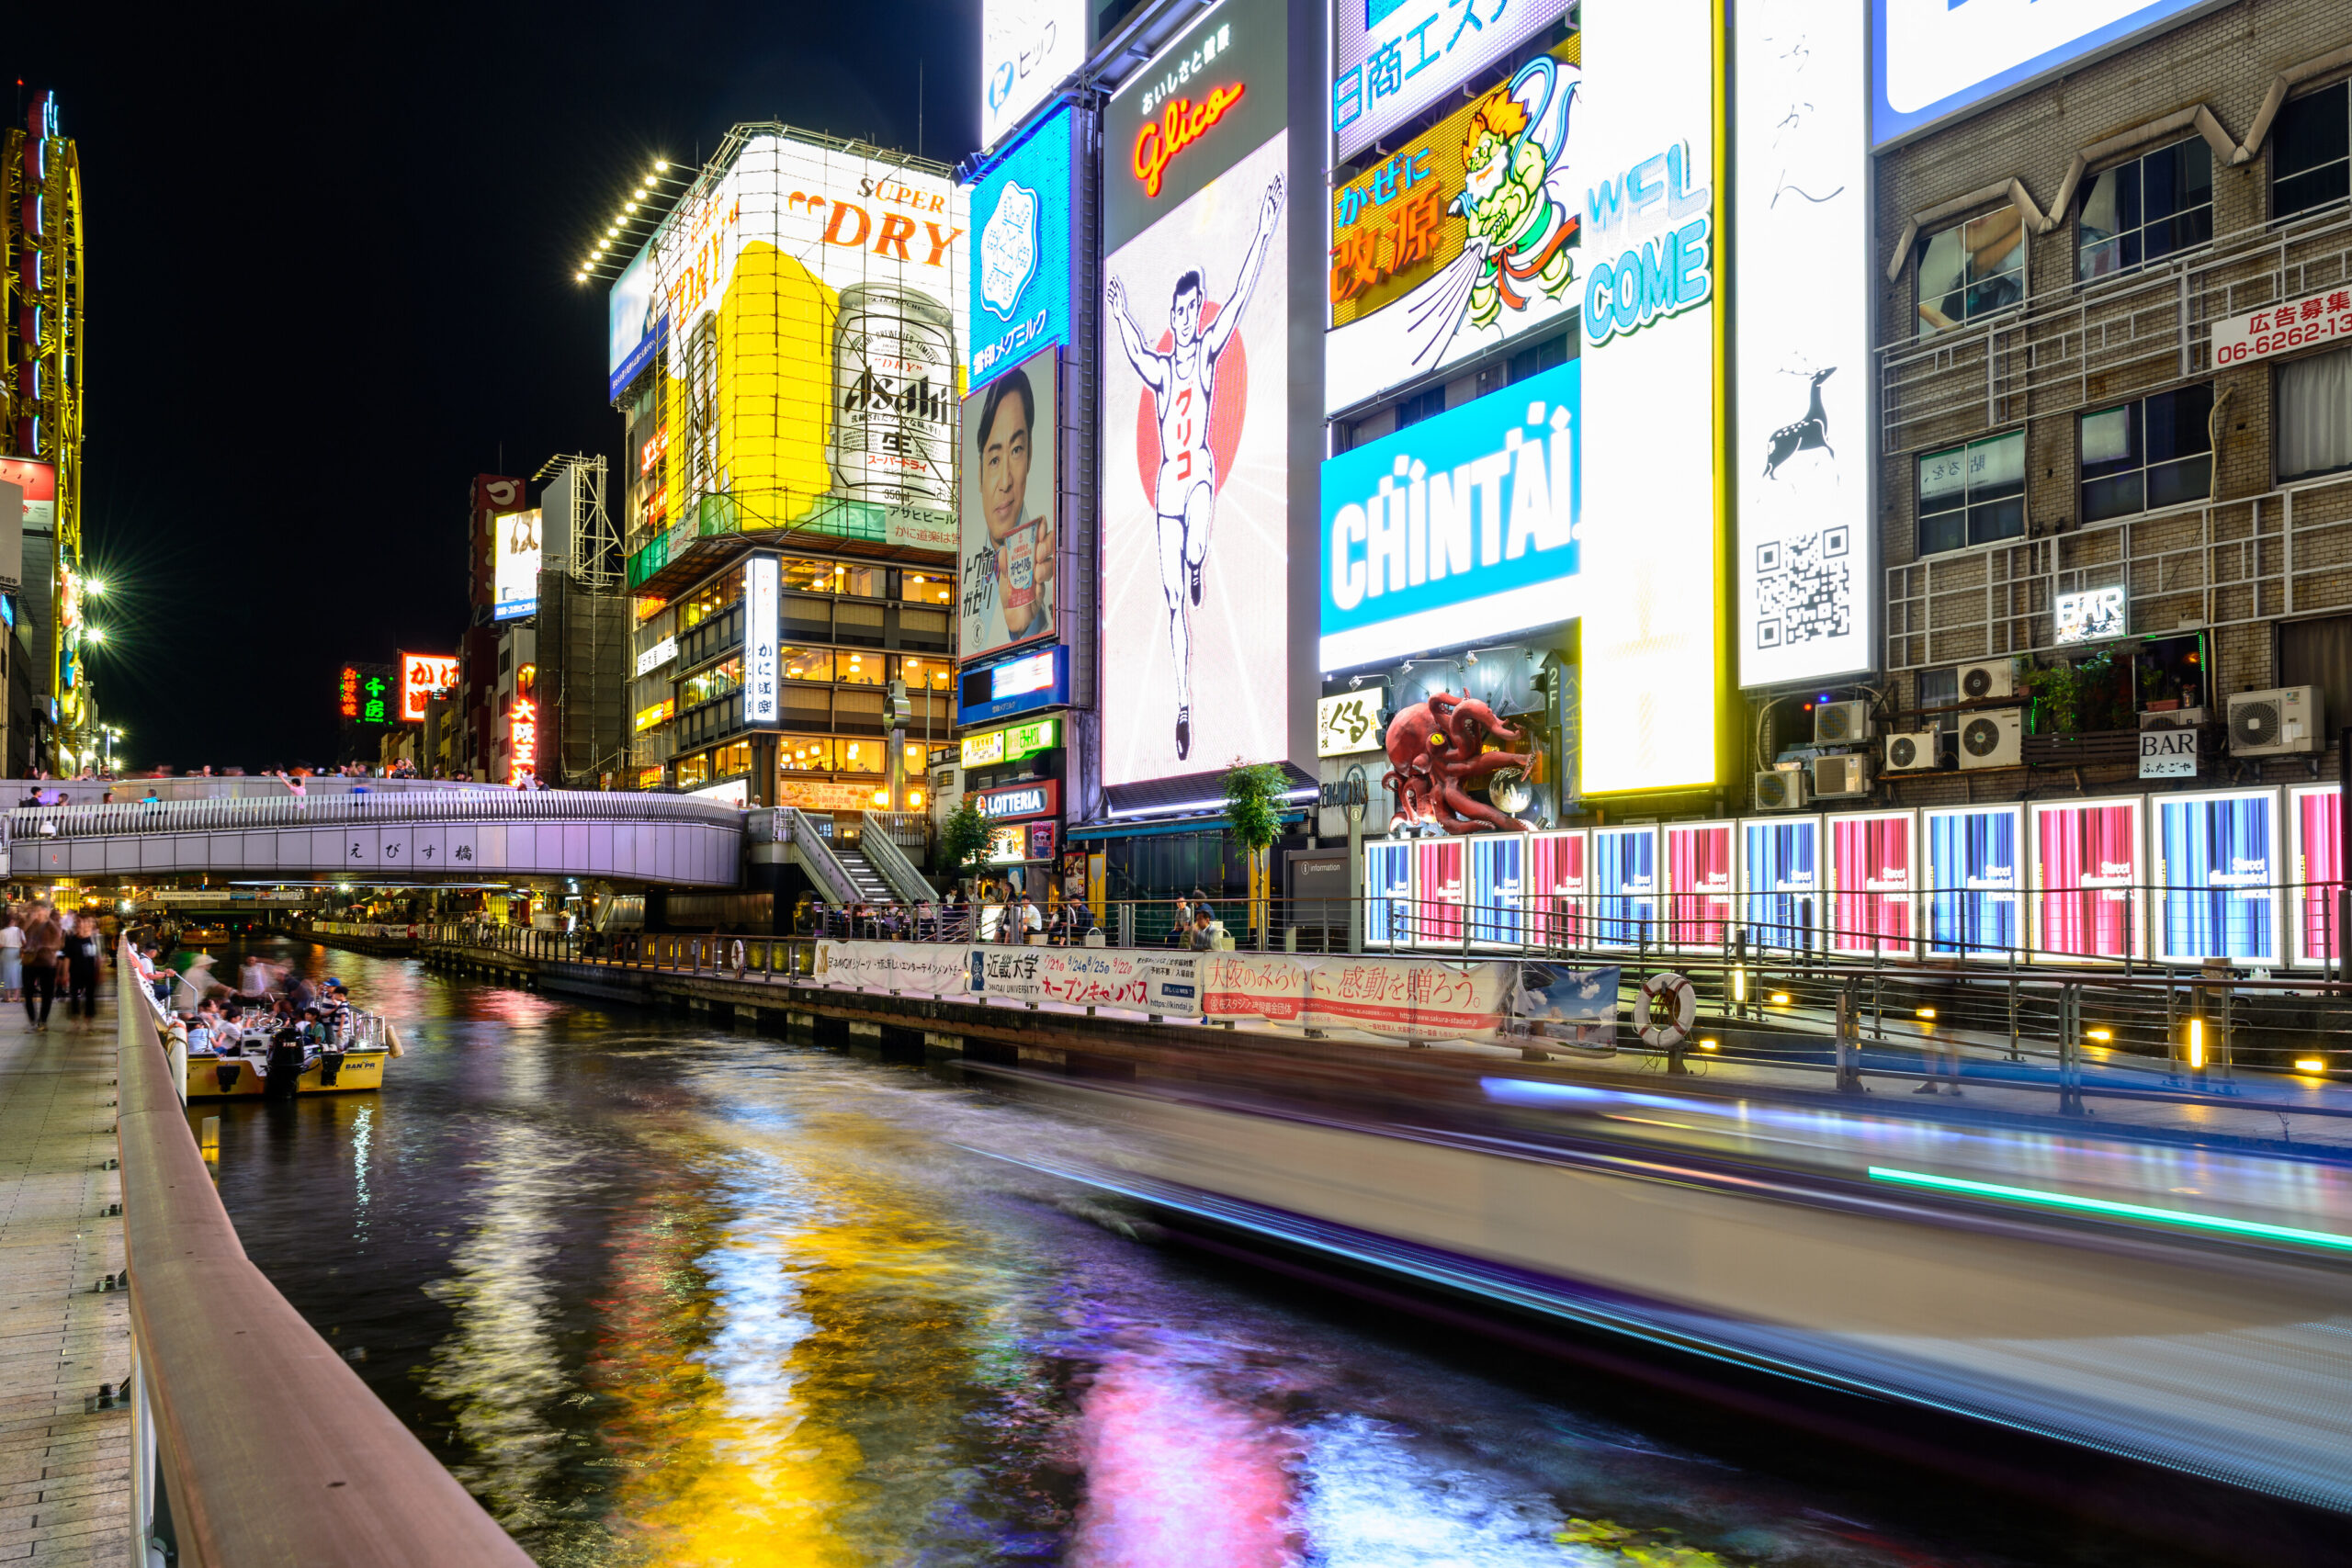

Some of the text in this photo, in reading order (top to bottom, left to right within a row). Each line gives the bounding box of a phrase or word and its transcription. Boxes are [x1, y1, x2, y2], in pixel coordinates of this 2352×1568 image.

[1142, 24, 1232, 115] おいしさと健康
[1134, 83, 1245, 197] Glico
[857, 178, 946, 214] SUPER
[1338, 147, 1431, 228] かぜに
[1587, 144, 1709, 233] WEL
[1329, 190, 1442, 305] 改源
[1584, 219, 1707, 340] COME
[2249, 290, 2351, 335] 広告募集
[973, 309, 1046, 375] 雪印メグミルク
[2217, 312, 2352, 365] 06-6262-13
[844, 365, 948, 427] Asahi
[882, 432, 913, 455] 生
[1176, 380, 1192, 481] グリコ
[867, 455, 928, 473] スーパードライ
[888, 505, 957, 525] アサヒビール
[964, 546, 994, 584] トクホ
[963, 582, 993, 618] ガセリ
[2141, 733, 2196, 757] BAR
[2143, 761, 2192, 773] ふたごや
[988, 790, 1041, 815] LOTTERIA
[350, 842, 472, 862] えびす橋
[1310, 863, 1340, 872] information
[987, 953, 1039, 979] 近畿大学
[1208, 957, 1481, 1009] 大阪のみらいに、感動を贈ろう。
[1007, 984, 1040, 994] UNIVERSITY
[1042, 976, 1148, 1005] オープンキャンパス
[1150, 998, 1194, 1012] https://kindai.jp
[1399, 1012, 1478, 1027] http://www.sakura-stadium.jp
